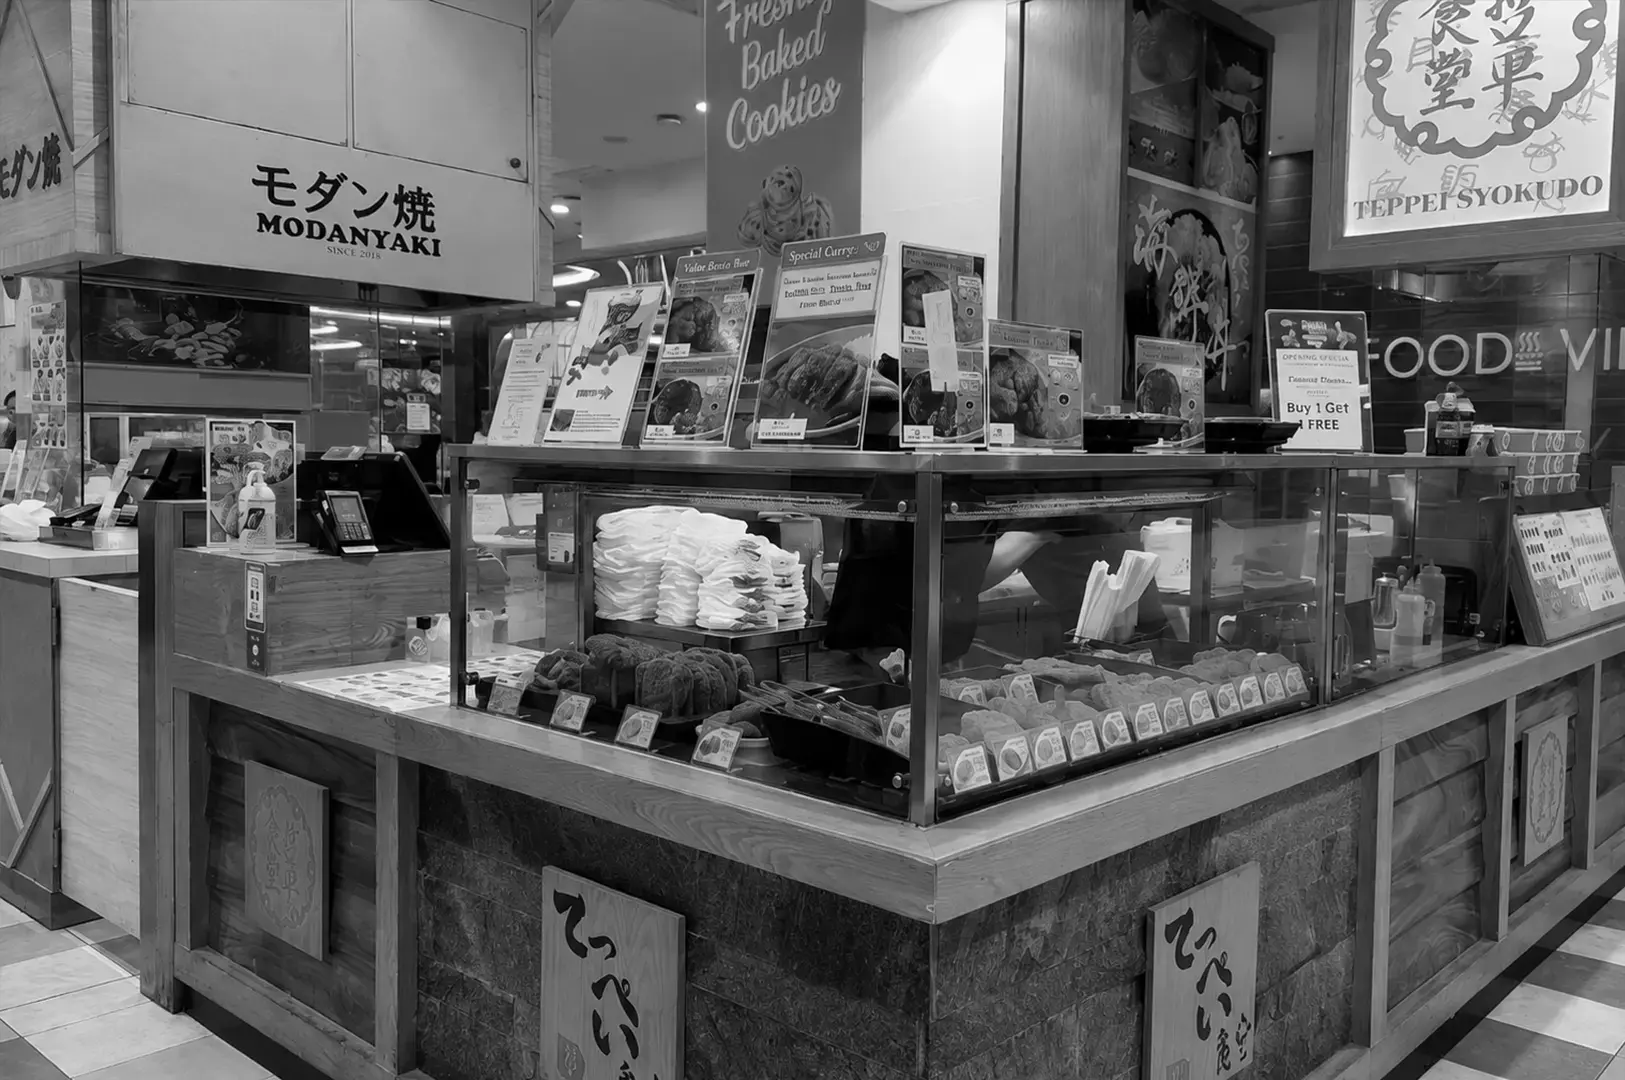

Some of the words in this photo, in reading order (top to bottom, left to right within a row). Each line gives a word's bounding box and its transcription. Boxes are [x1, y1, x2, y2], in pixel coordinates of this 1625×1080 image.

[742, 10, 827, 90] Baked
[726, 76, 842, 149] Cookies
[251, 164, 436, 233] モダン焼
[1353, 191, 1448, 220] TEPPEI
[1456, 175, 1603, 209] SYOKUDO
[256, 212, 441, 257] MODANYAKI
[326, 245, 357, 257] SINCE
[360, 250, 382, 260] 2018
[789, 247, 822, 265] Special
[1368, 332, 1513, 378] OOD
[1287, 402, 1311, 415] Buy
[1316, 402, 1321, 413] 1
[1325, 401, 1349, 414] Get
[1308, 419, 1340, 430] FREE
